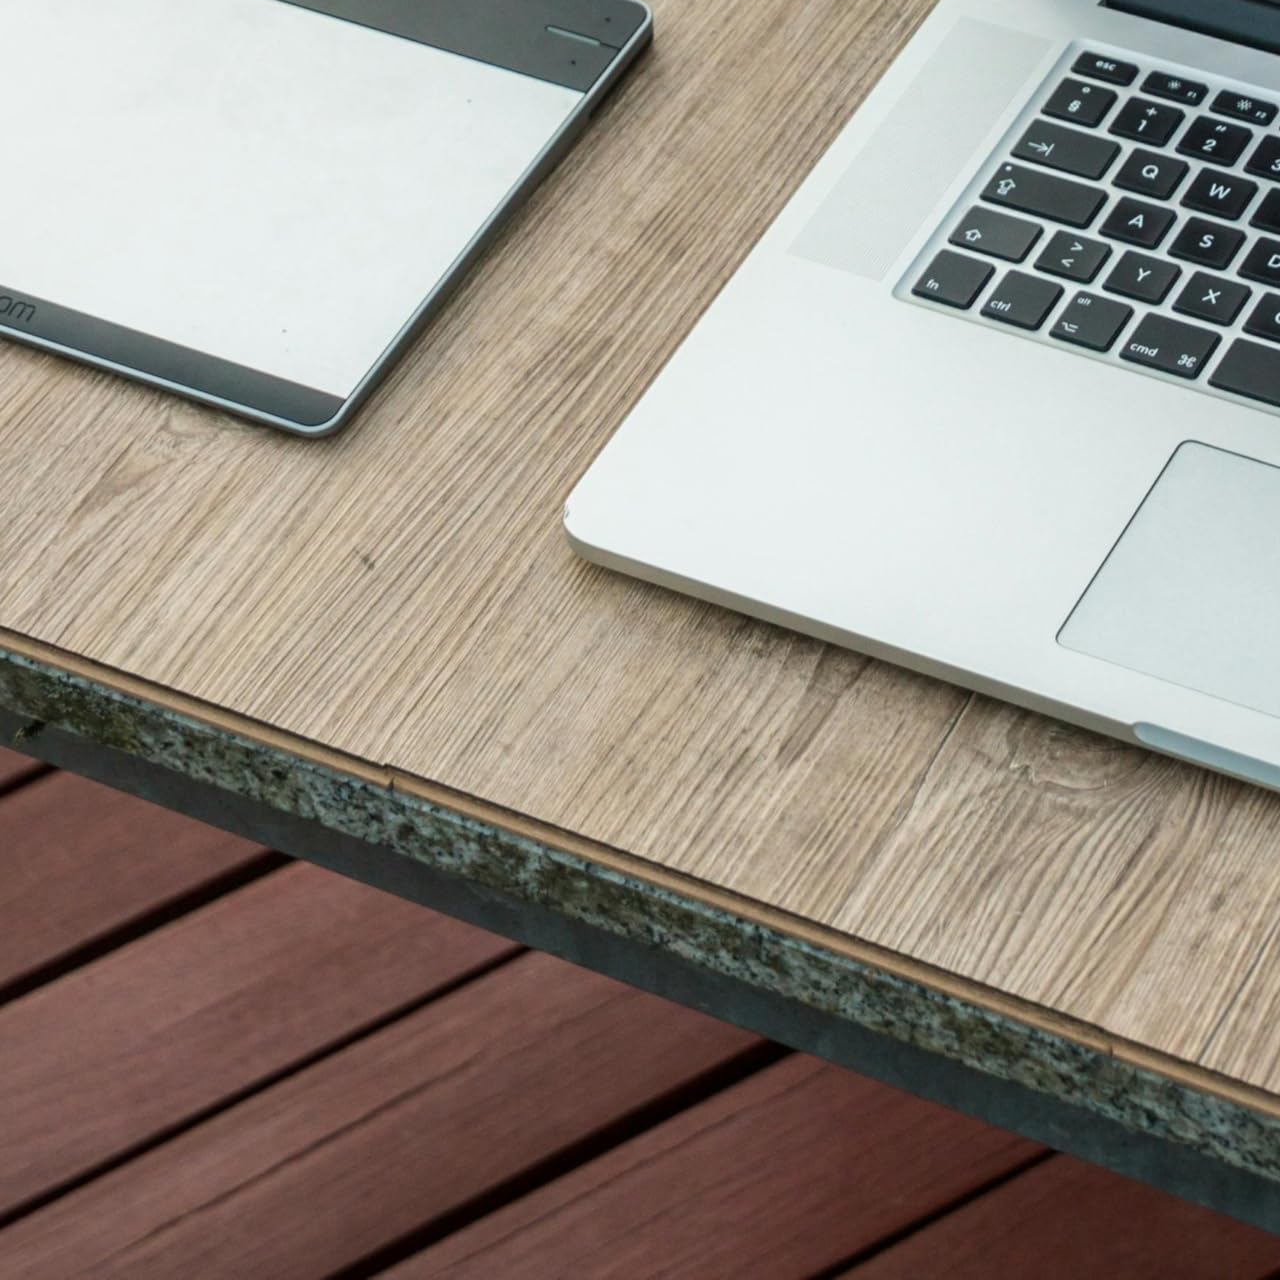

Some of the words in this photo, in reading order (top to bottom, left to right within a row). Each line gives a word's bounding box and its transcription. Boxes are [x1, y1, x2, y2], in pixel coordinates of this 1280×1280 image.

[1096, 58, 1116, 72] esc
[1139, 120, 1147, 131] 1
[1203, 139, 1216, 151] 2
[1142, 165, 1158, 179] Q
[1210, 184, 1231, 199] W
[1128, 215, 1143, 228] A
[1200, 235, 1214, 247] S
[1138, 268, 1151, 281] Y
[927, 279, 939, 289] fn
[1077, 295, 1092, 306] alt
[1202, 289, 1220, 304] X
[990, 298, 1011, 313] ctrl
[1129, 341, 1158, 358] cmd
